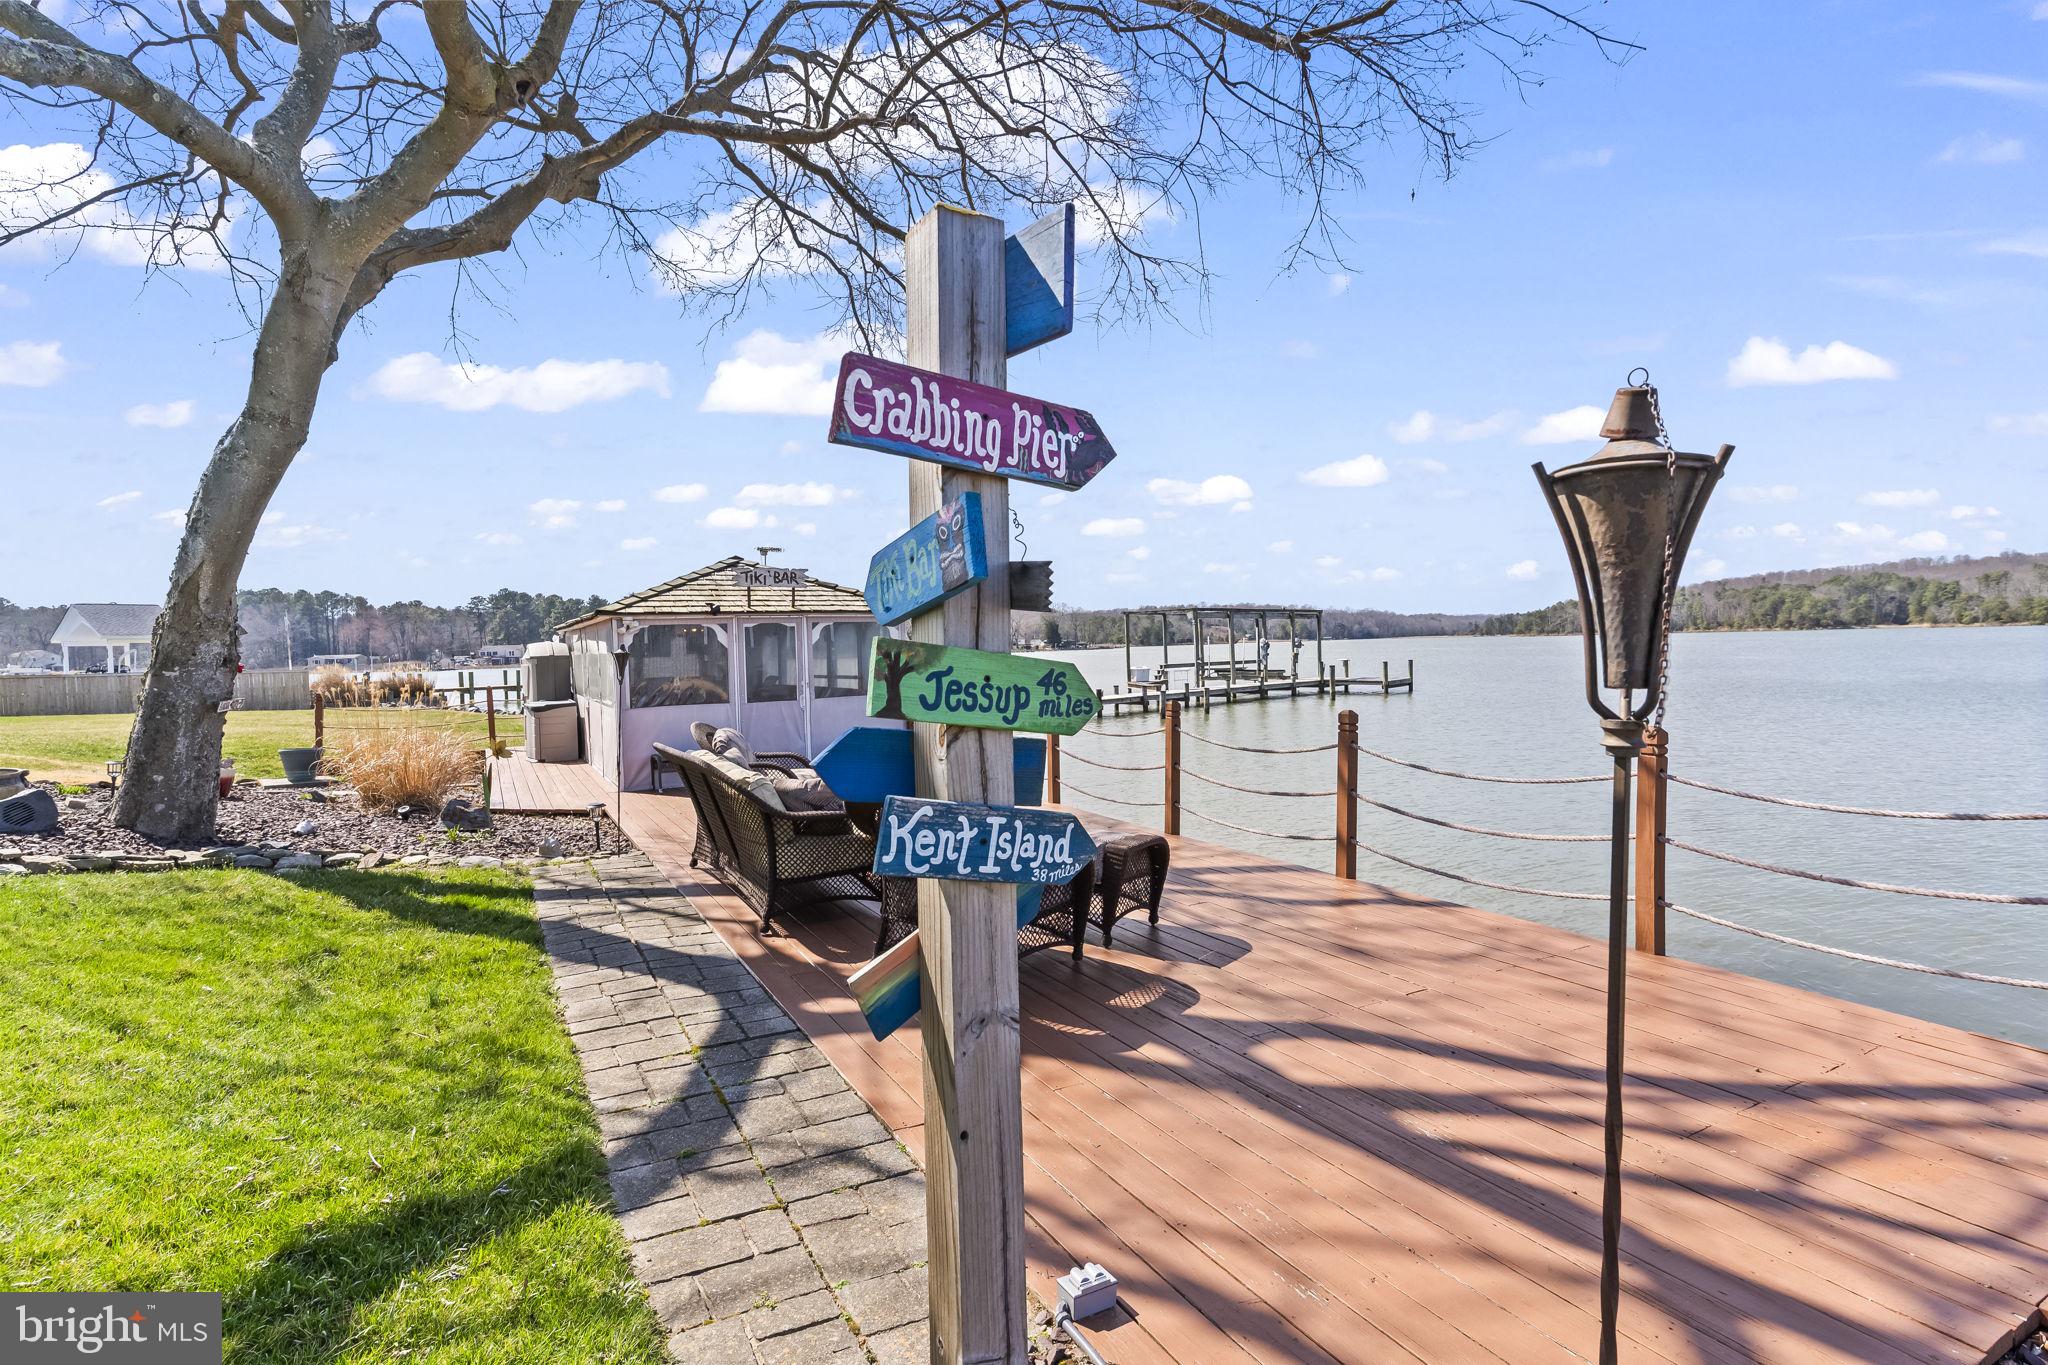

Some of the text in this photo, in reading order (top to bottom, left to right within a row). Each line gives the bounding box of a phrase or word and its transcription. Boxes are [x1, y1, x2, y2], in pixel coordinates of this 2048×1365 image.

[843, 368, 1077, 479] Crabbing Pier
[740, 570, 799, 585] TIKI BAR
[902, 538, 939, 600] Bar
[918, 665, 1067, 726] Jessup 46
[1038, 694, 1094, 719] miles
[882, 805, 1075, 875] Kent Island
[1031, 863, 1083, 883] 38 miles
